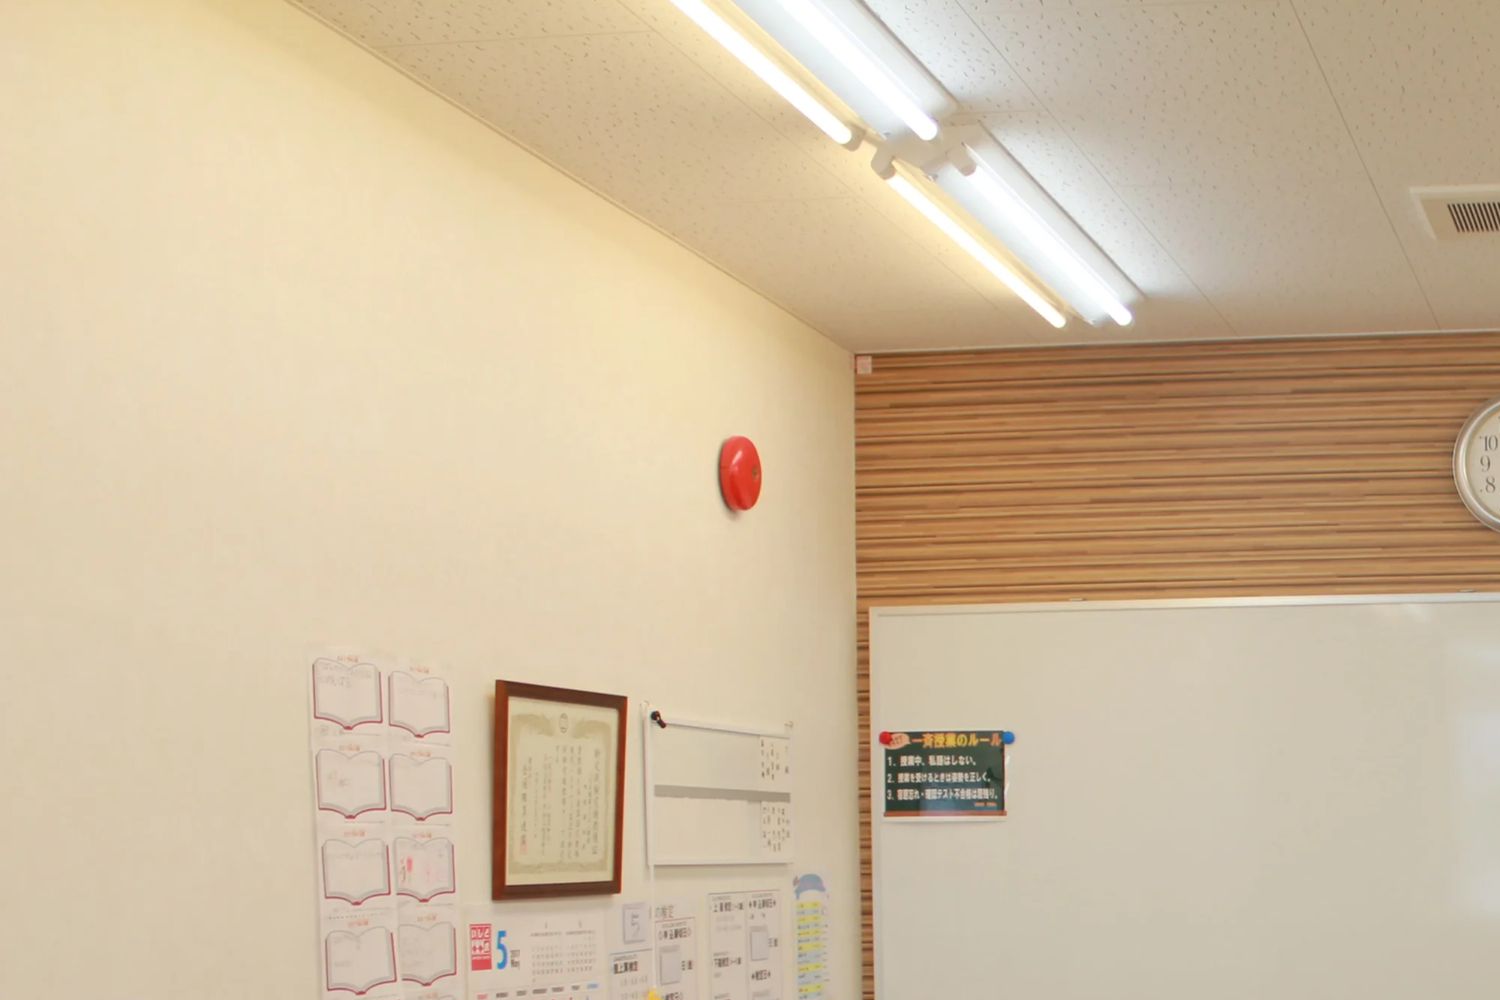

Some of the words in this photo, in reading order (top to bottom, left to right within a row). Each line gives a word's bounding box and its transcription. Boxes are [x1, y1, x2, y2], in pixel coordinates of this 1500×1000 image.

[1484, 435, 1499, 451] 10
[1480, 456, 1490, 472] 9
[1486, 476, 1496, 493] 8
[496, 930, 508, 970] 5
